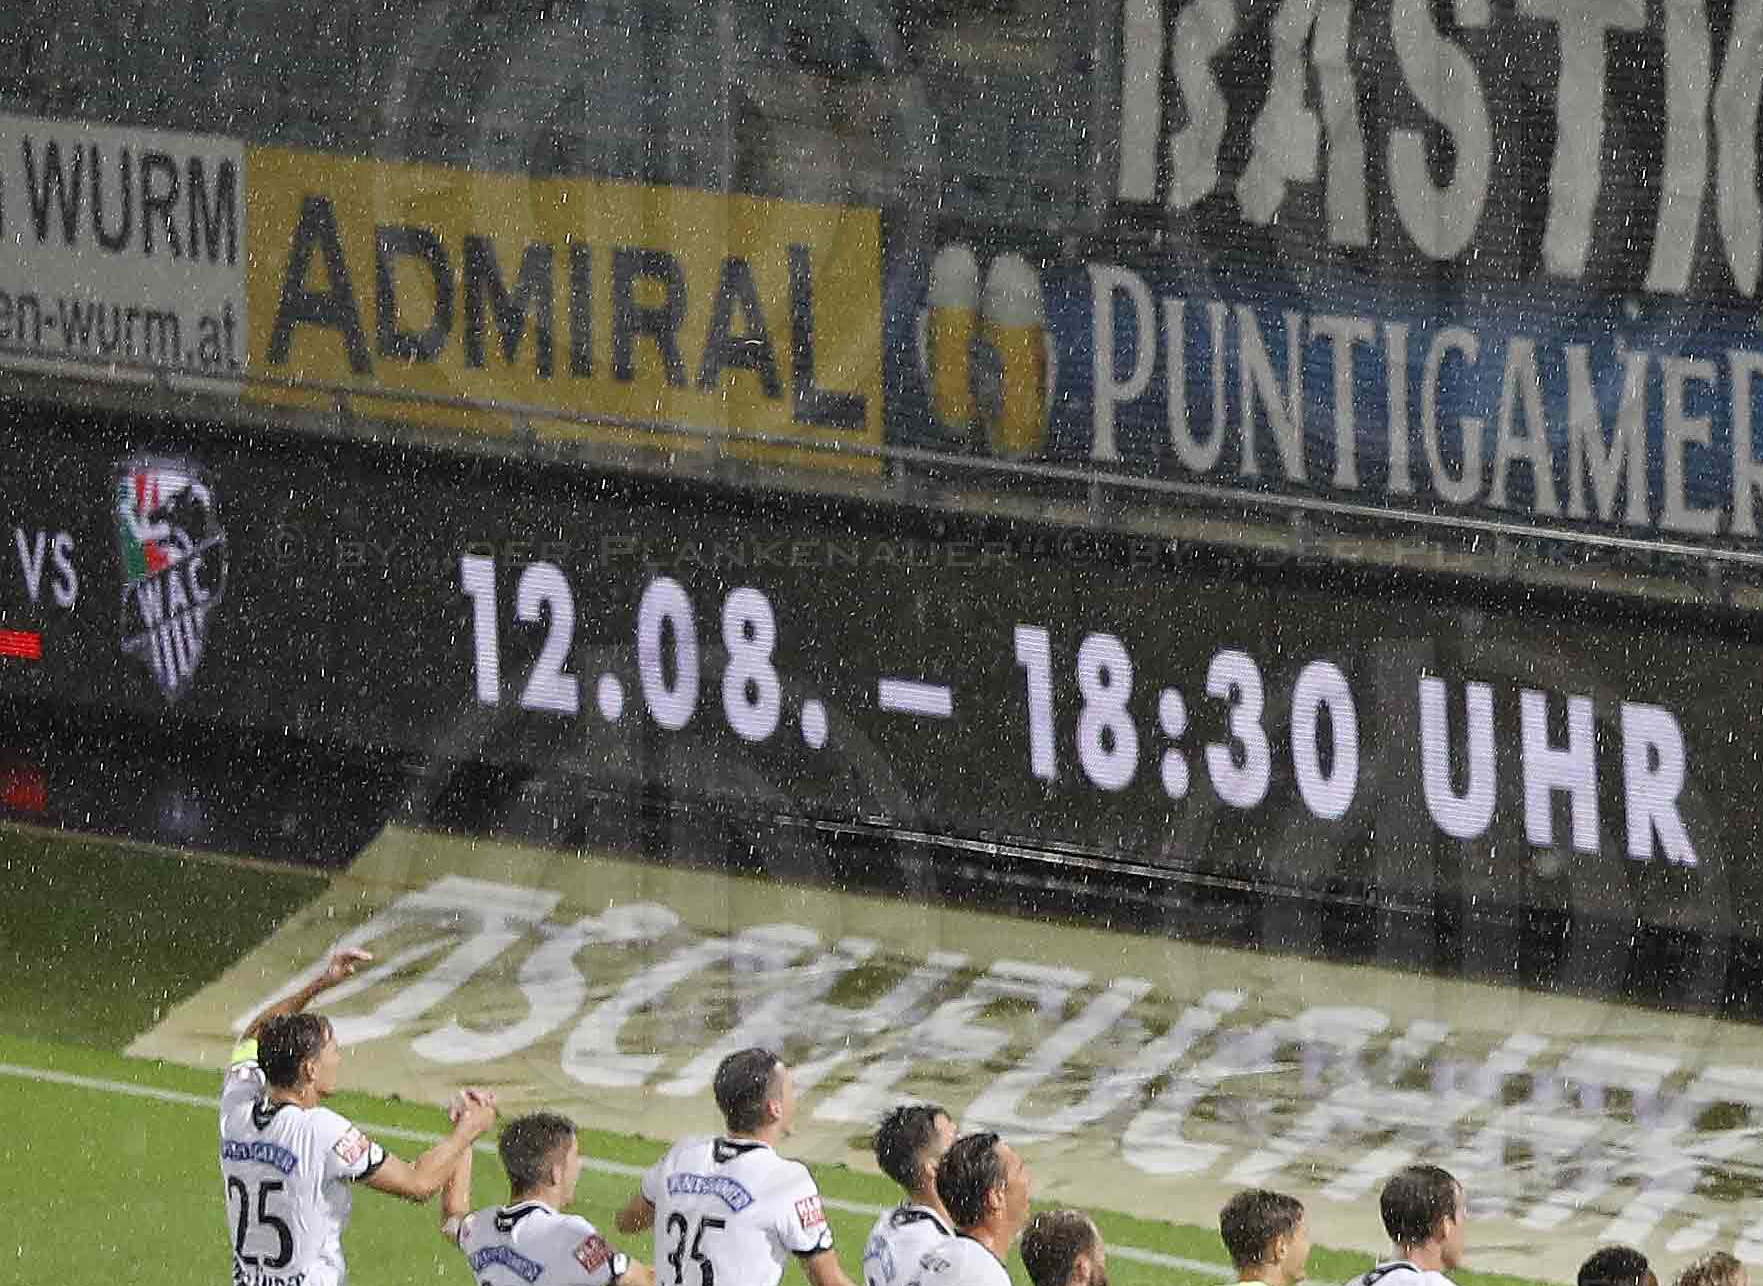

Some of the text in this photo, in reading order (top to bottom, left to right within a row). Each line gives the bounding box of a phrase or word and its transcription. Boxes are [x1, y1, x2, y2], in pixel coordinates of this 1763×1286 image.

[22, 134, 238, 266] WURM
[266, 195, 868, 431] ADMIRAL
[15, 526, 78, 609] VS
[460, 553, 829, 750] 12.08.
[1013, 622, 1360, 820] 18:30
[1417, 675, 1699, 868] UHR
[228, 1176, 294, 1268] 25
